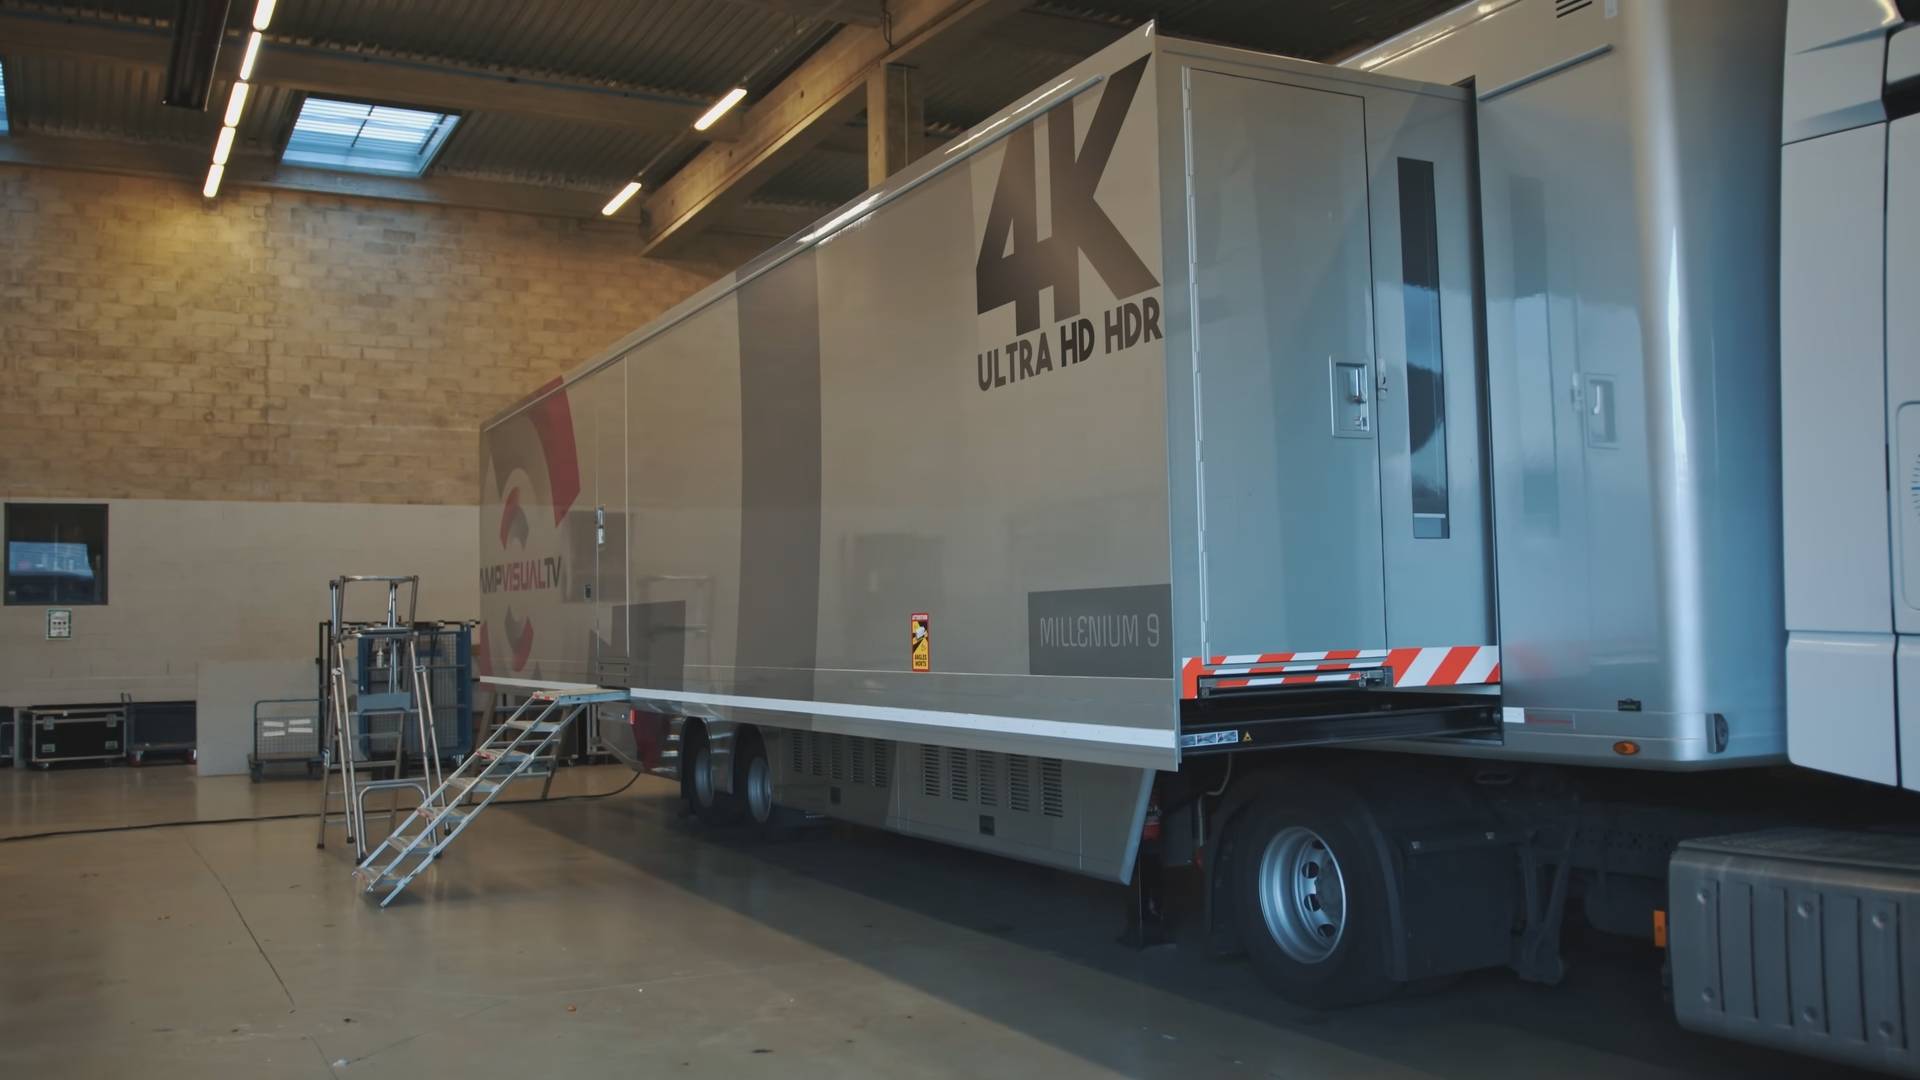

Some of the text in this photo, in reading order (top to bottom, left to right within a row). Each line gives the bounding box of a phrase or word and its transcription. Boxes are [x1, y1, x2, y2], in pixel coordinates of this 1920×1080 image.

[976, 52, 1161, 337] 4K
[977, 296, 1163, 392] ULTRA HD HDR
[1040, 613, 1160, 648] MILLENIUM 9
